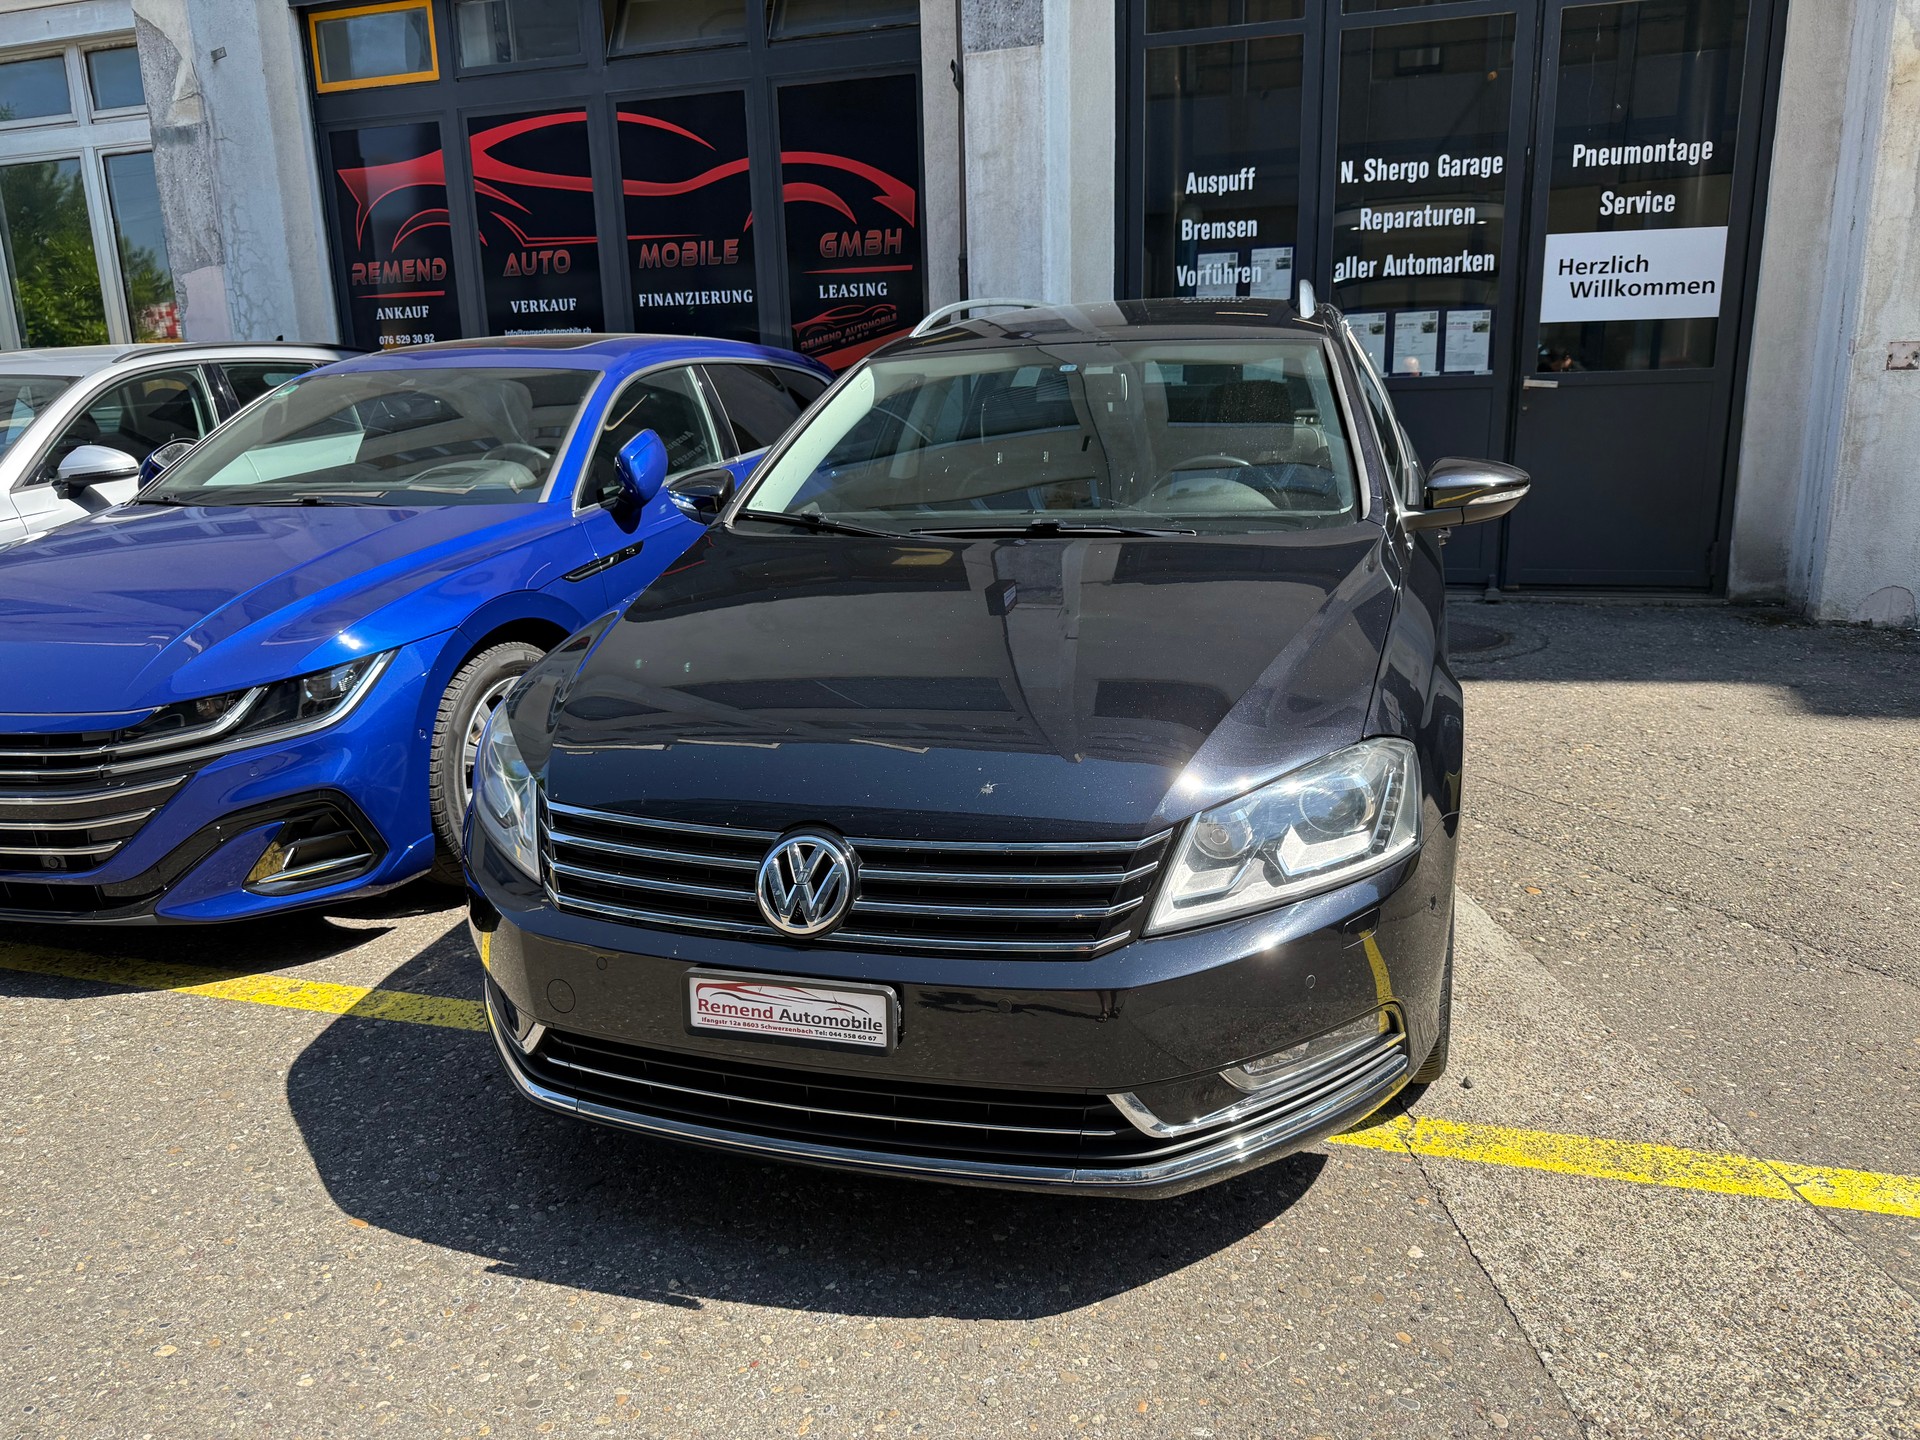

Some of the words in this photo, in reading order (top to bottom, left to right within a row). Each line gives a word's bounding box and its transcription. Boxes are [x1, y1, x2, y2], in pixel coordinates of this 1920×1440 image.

[1572, 138, 1713, 167] Pneumontage
[1185, 166, 1256, 196] Auspuff
[1340, 160, 1359, 184] N.
[1363, 157, 1430, 184] Shergo
[1437, 153, 1504, 179] Garage
[1600, 190, 1676, 215] Service
[1181, 218, 1259, 241] Bremsen
[1359, 205, 1476, 234] Reparaturen
[638, 238, 740, 270] MOBILE
[819, 228, 903, 260] GMBH
[351, 257, 448, 286] REMEND
[503, 249, 571, 277] AUTO
[1176, 261, 1263, 288] Vorführen
[1334, 257, 1377, 281] aller
[1382, 249, 1496, 278] Automarken
[1558, 254, 1650, 276] Herzlich
[638, 289, 754, 308] FINANZIERUNG
[818, 282, 889, 300] LEASING
[1569, 279, 1717, 299] Willkommen
[376, 305, 430, 321] ANKAUF
[510, 298, 578, 314] VERKAUF
[379, 335, 394, 345] 076
[395, 335, 411, 344] 529
[412, 334, 423, 344] 30
[424, 333, 435, 343] 92
[801, 331, 841, 350] REMEND
[699, 998, 774, 1020] Remend
[779, 1008, 883, 1032] Automobile
[742, 1021, 760, 1030] 8603
[760, 1023, 814, 1035] Schwerzenbach
